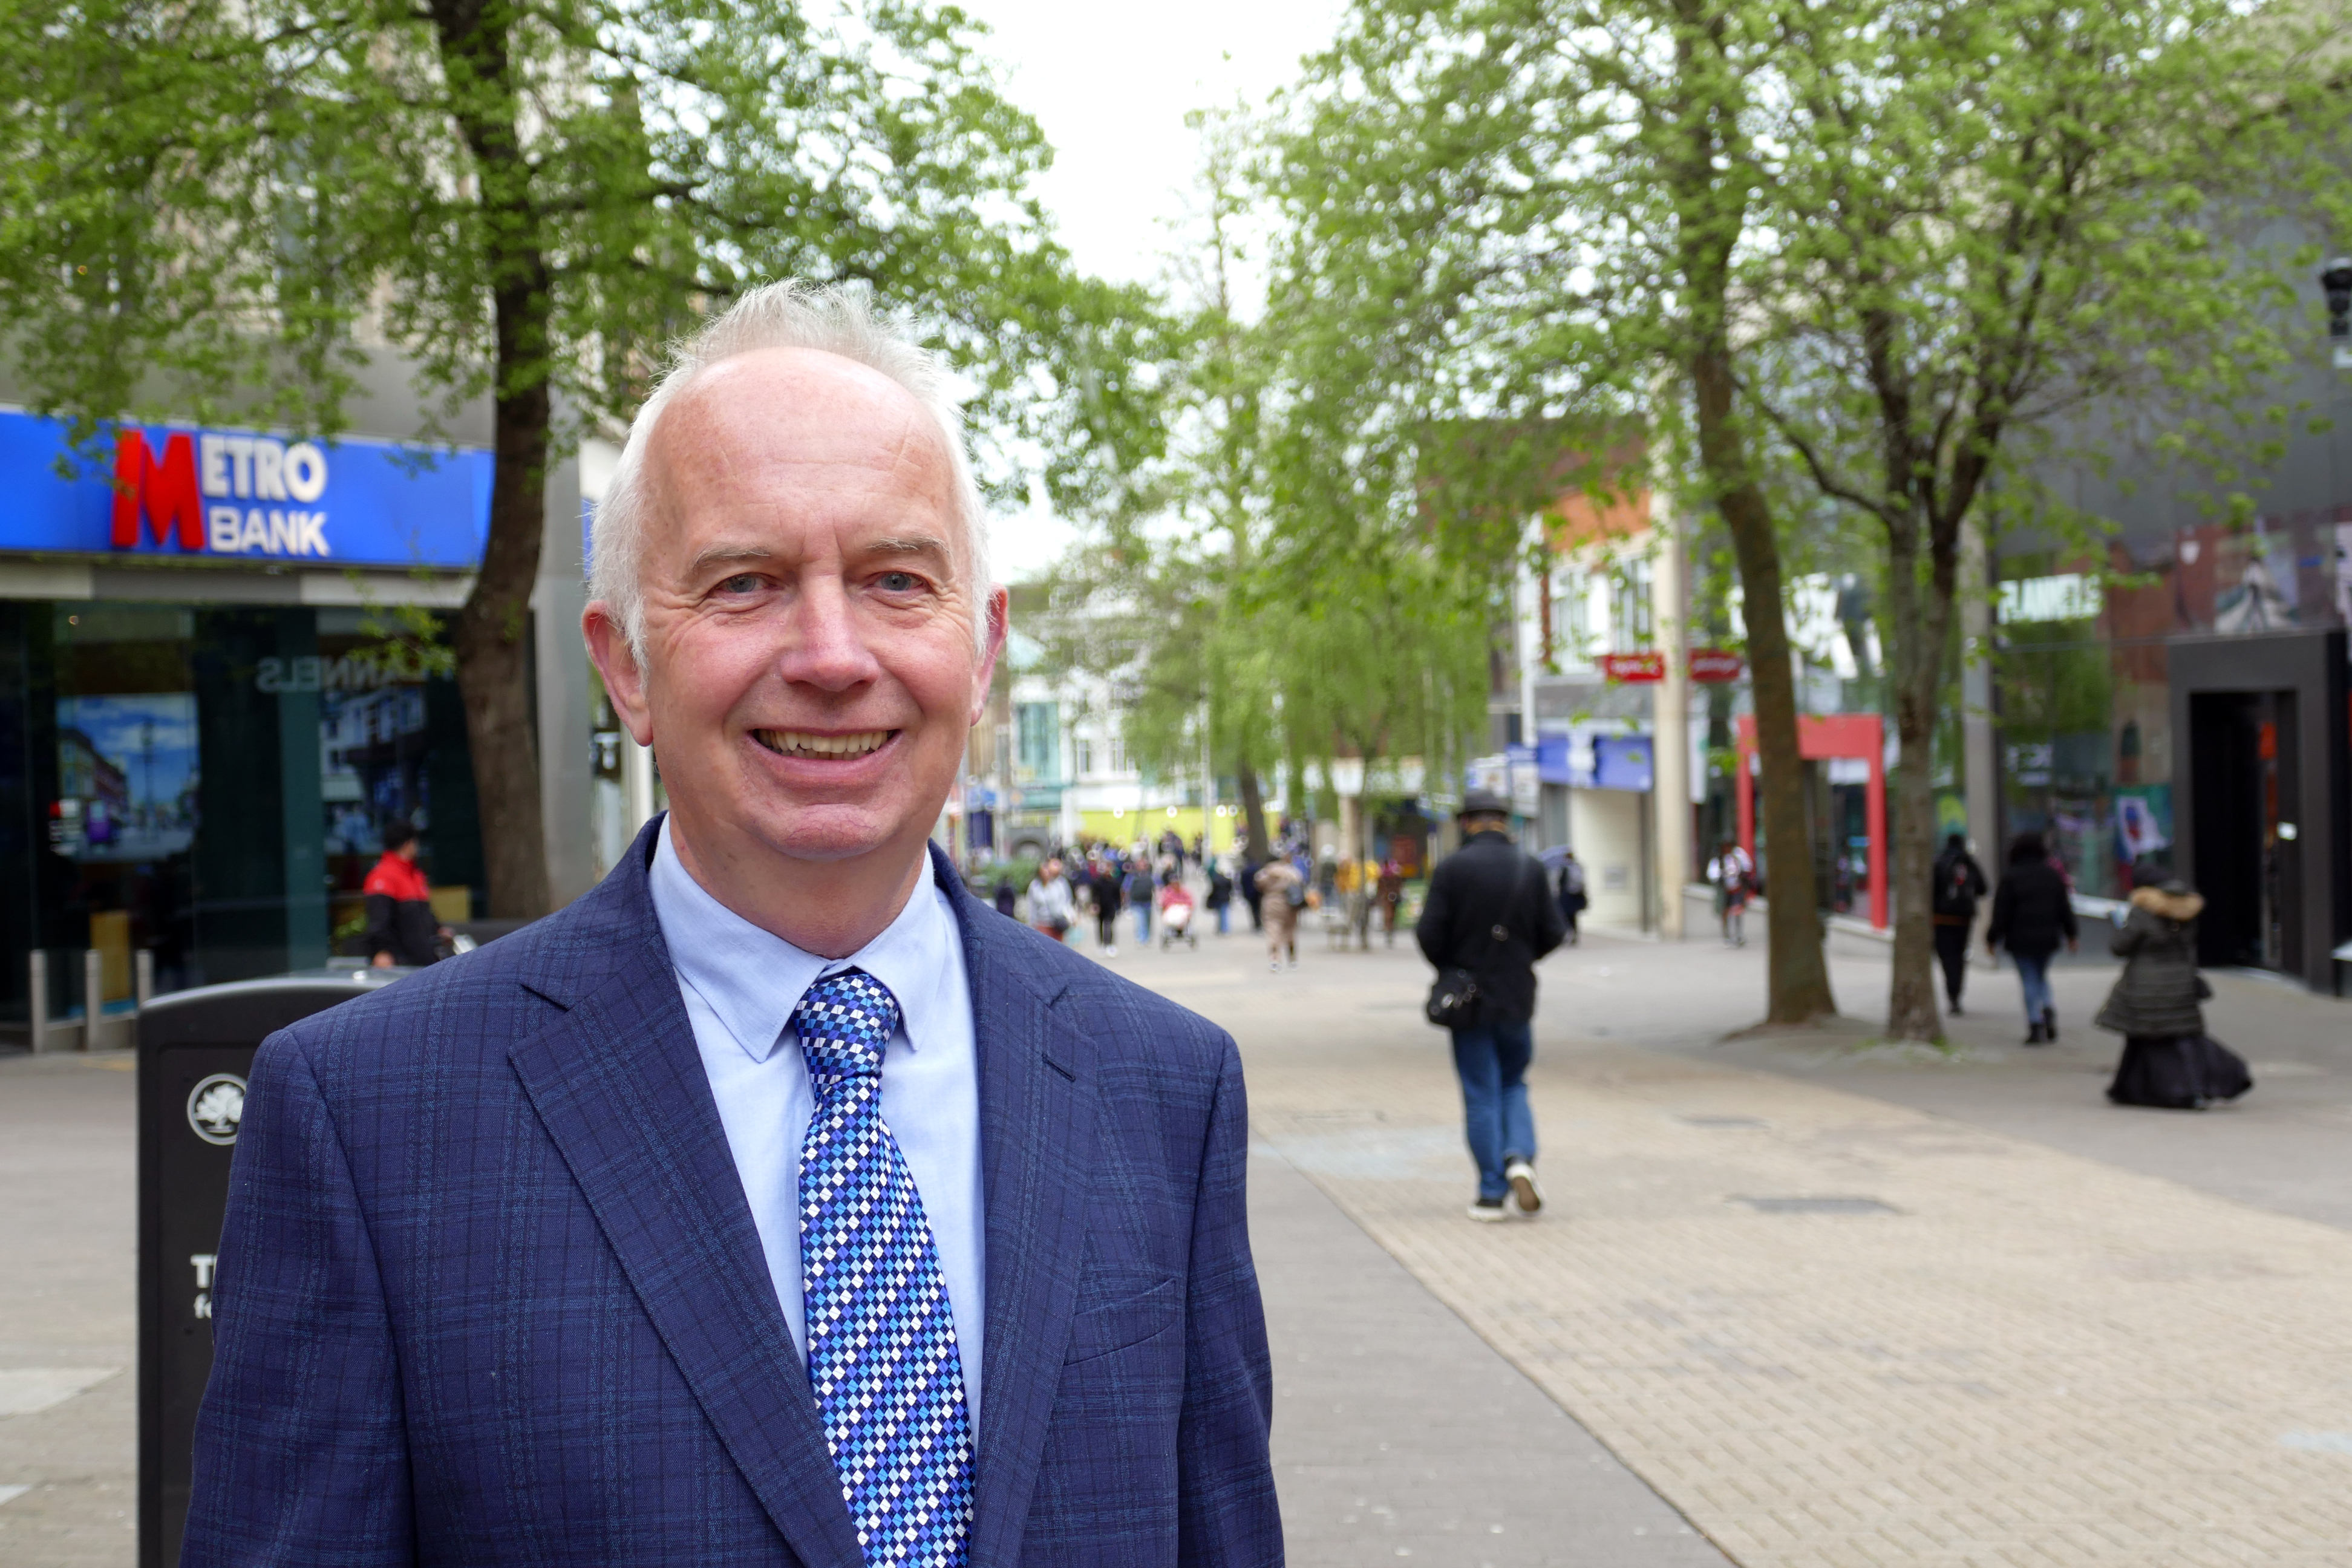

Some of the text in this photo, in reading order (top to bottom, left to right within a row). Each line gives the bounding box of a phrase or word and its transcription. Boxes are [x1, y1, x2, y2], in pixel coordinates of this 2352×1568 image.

[113, 428, 326, 550] METRO
[209, 506, 331, 557] BANK
[190, 1253, 218, 1289] T
